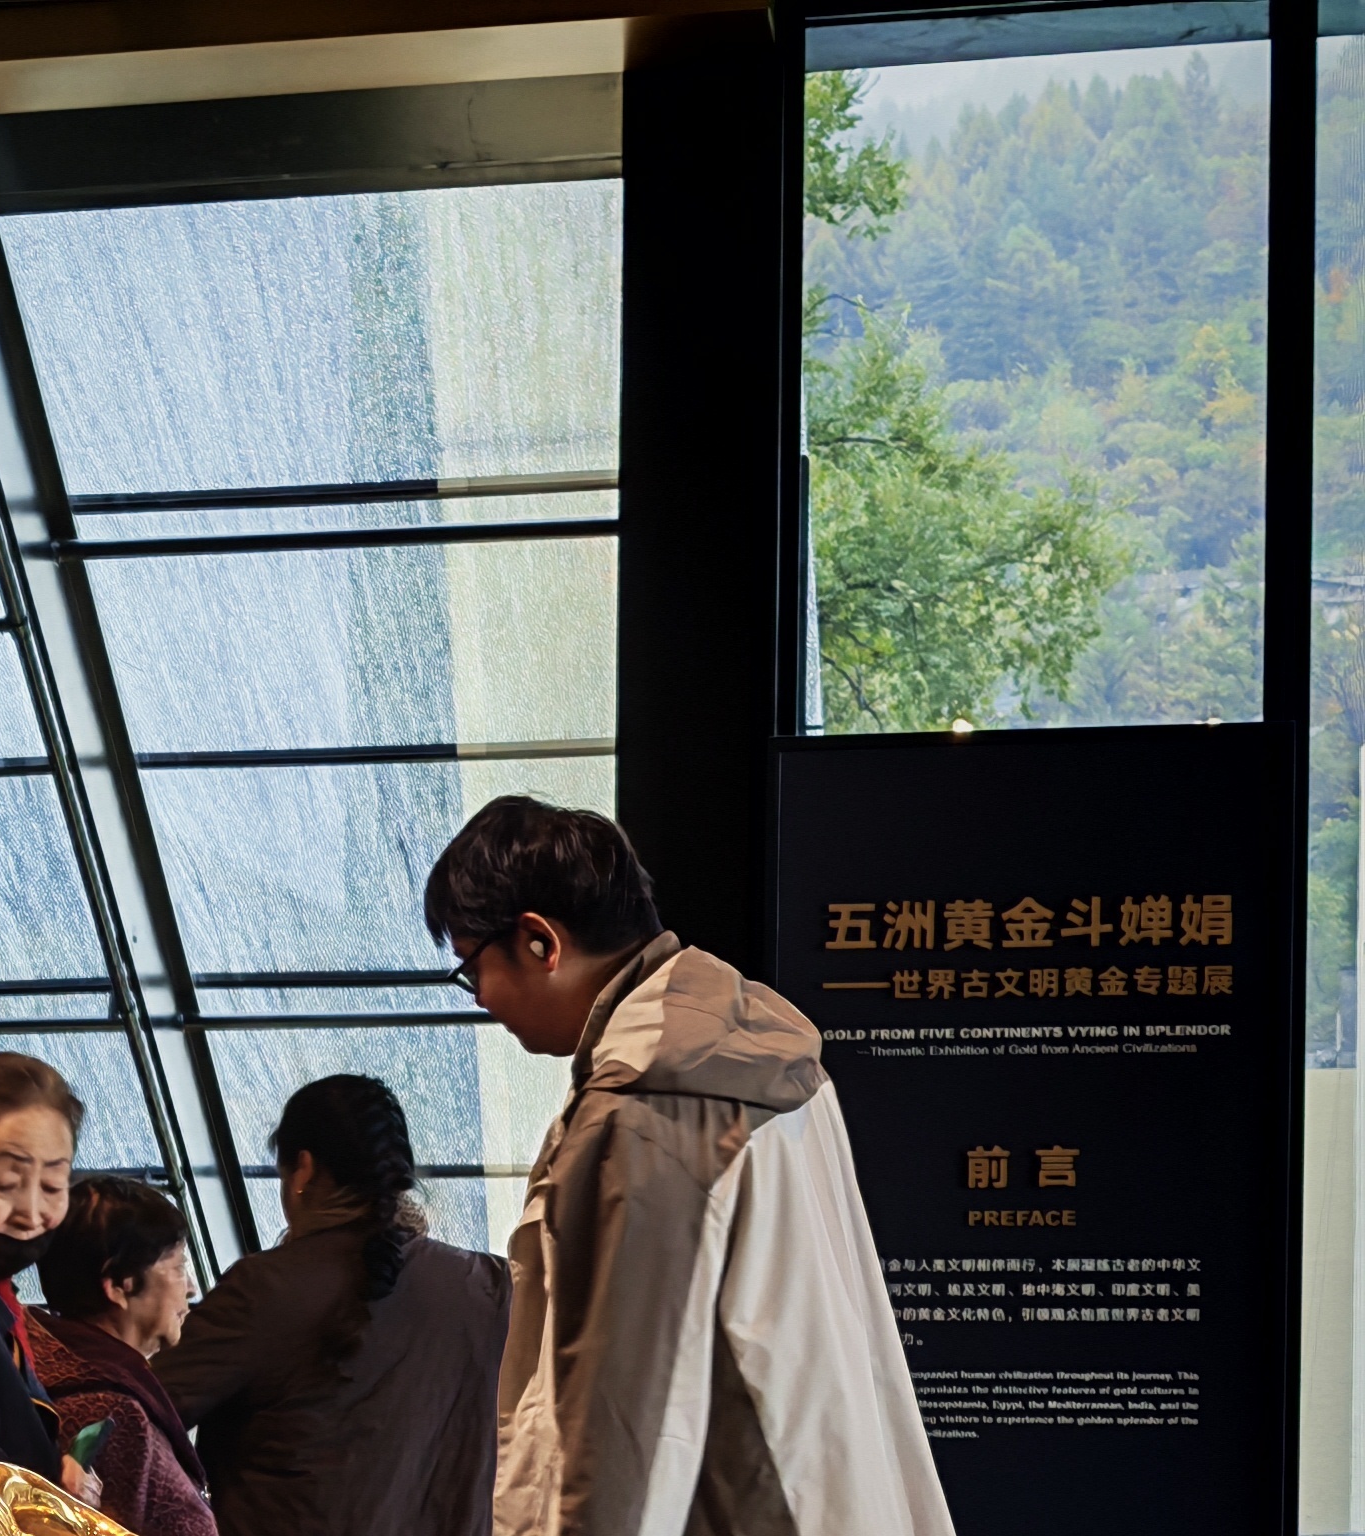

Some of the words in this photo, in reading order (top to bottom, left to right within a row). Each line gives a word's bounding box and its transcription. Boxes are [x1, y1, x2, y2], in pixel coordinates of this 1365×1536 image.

[825, 894, 1234, 951] 五洲黄金斗婵娟
[823, 1029, 866, 1041] GOLD
[870, 1028, 916, 1040] FROM
[919, 1028, 955, 1039] FIVE
[959, 1026, 1063, 1039] CONTINENTS
[1067, 1025, 1119, 1038] VYING
[1123, 1025, 1140, 1037] IN
[1145, 1024, 1231, 1037] SPLENDOR
[929, 1044, 990, 1056] Exhibition
[992, 1044, 1005, 1055] of
[1008, 1043, 1038, 1055] Gold
[1041, 1043, 1069, 1054] from
[1072, 1042, 1119, 1054] Ancient
[968, 1210, 1077, 1226] PREFACE
